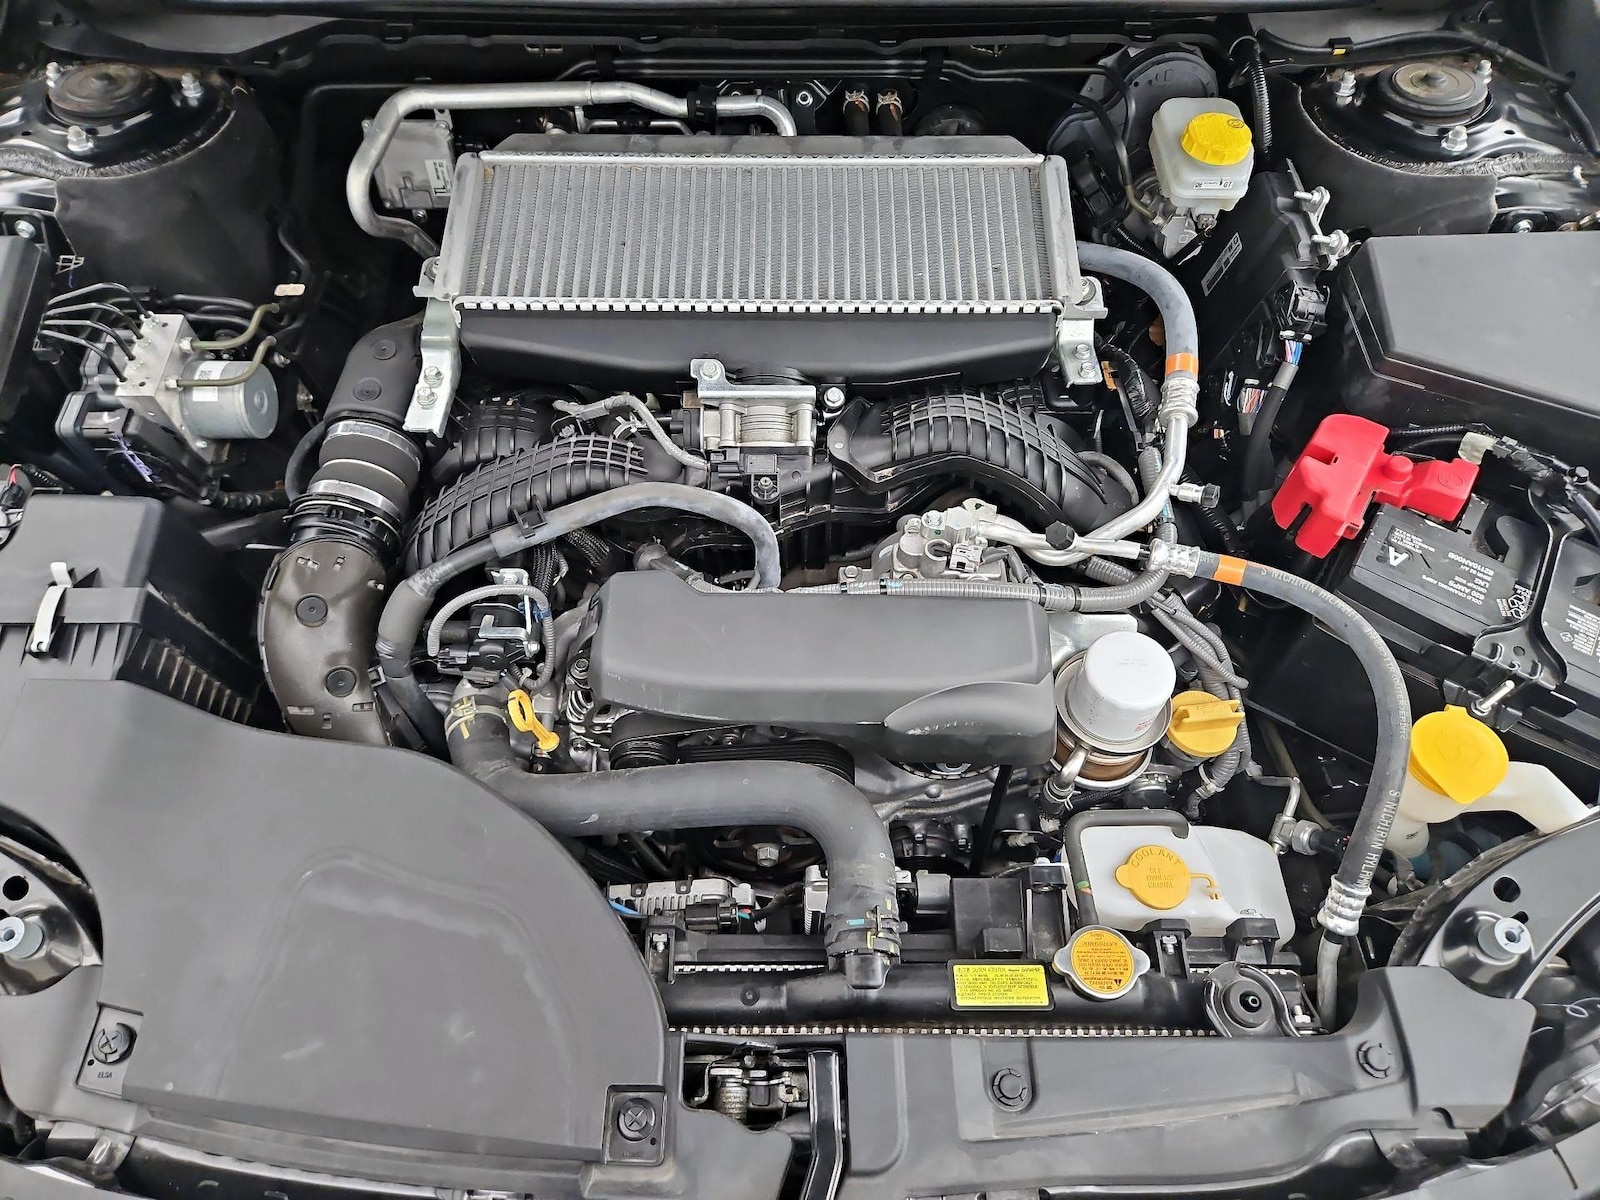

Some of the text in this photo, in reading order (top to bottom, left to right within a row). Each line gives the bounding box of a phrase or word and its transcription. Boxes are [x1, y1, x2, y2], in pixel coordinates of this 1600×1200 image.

[1389, 545, 1408, 566] A
[1447, 579, 1470, 593] AMPS
[1473, 576, 1489, 587] LN2
[1466, 594, 1482, 605] COLD
[1131, 848, 1181, 868] COOLANT
